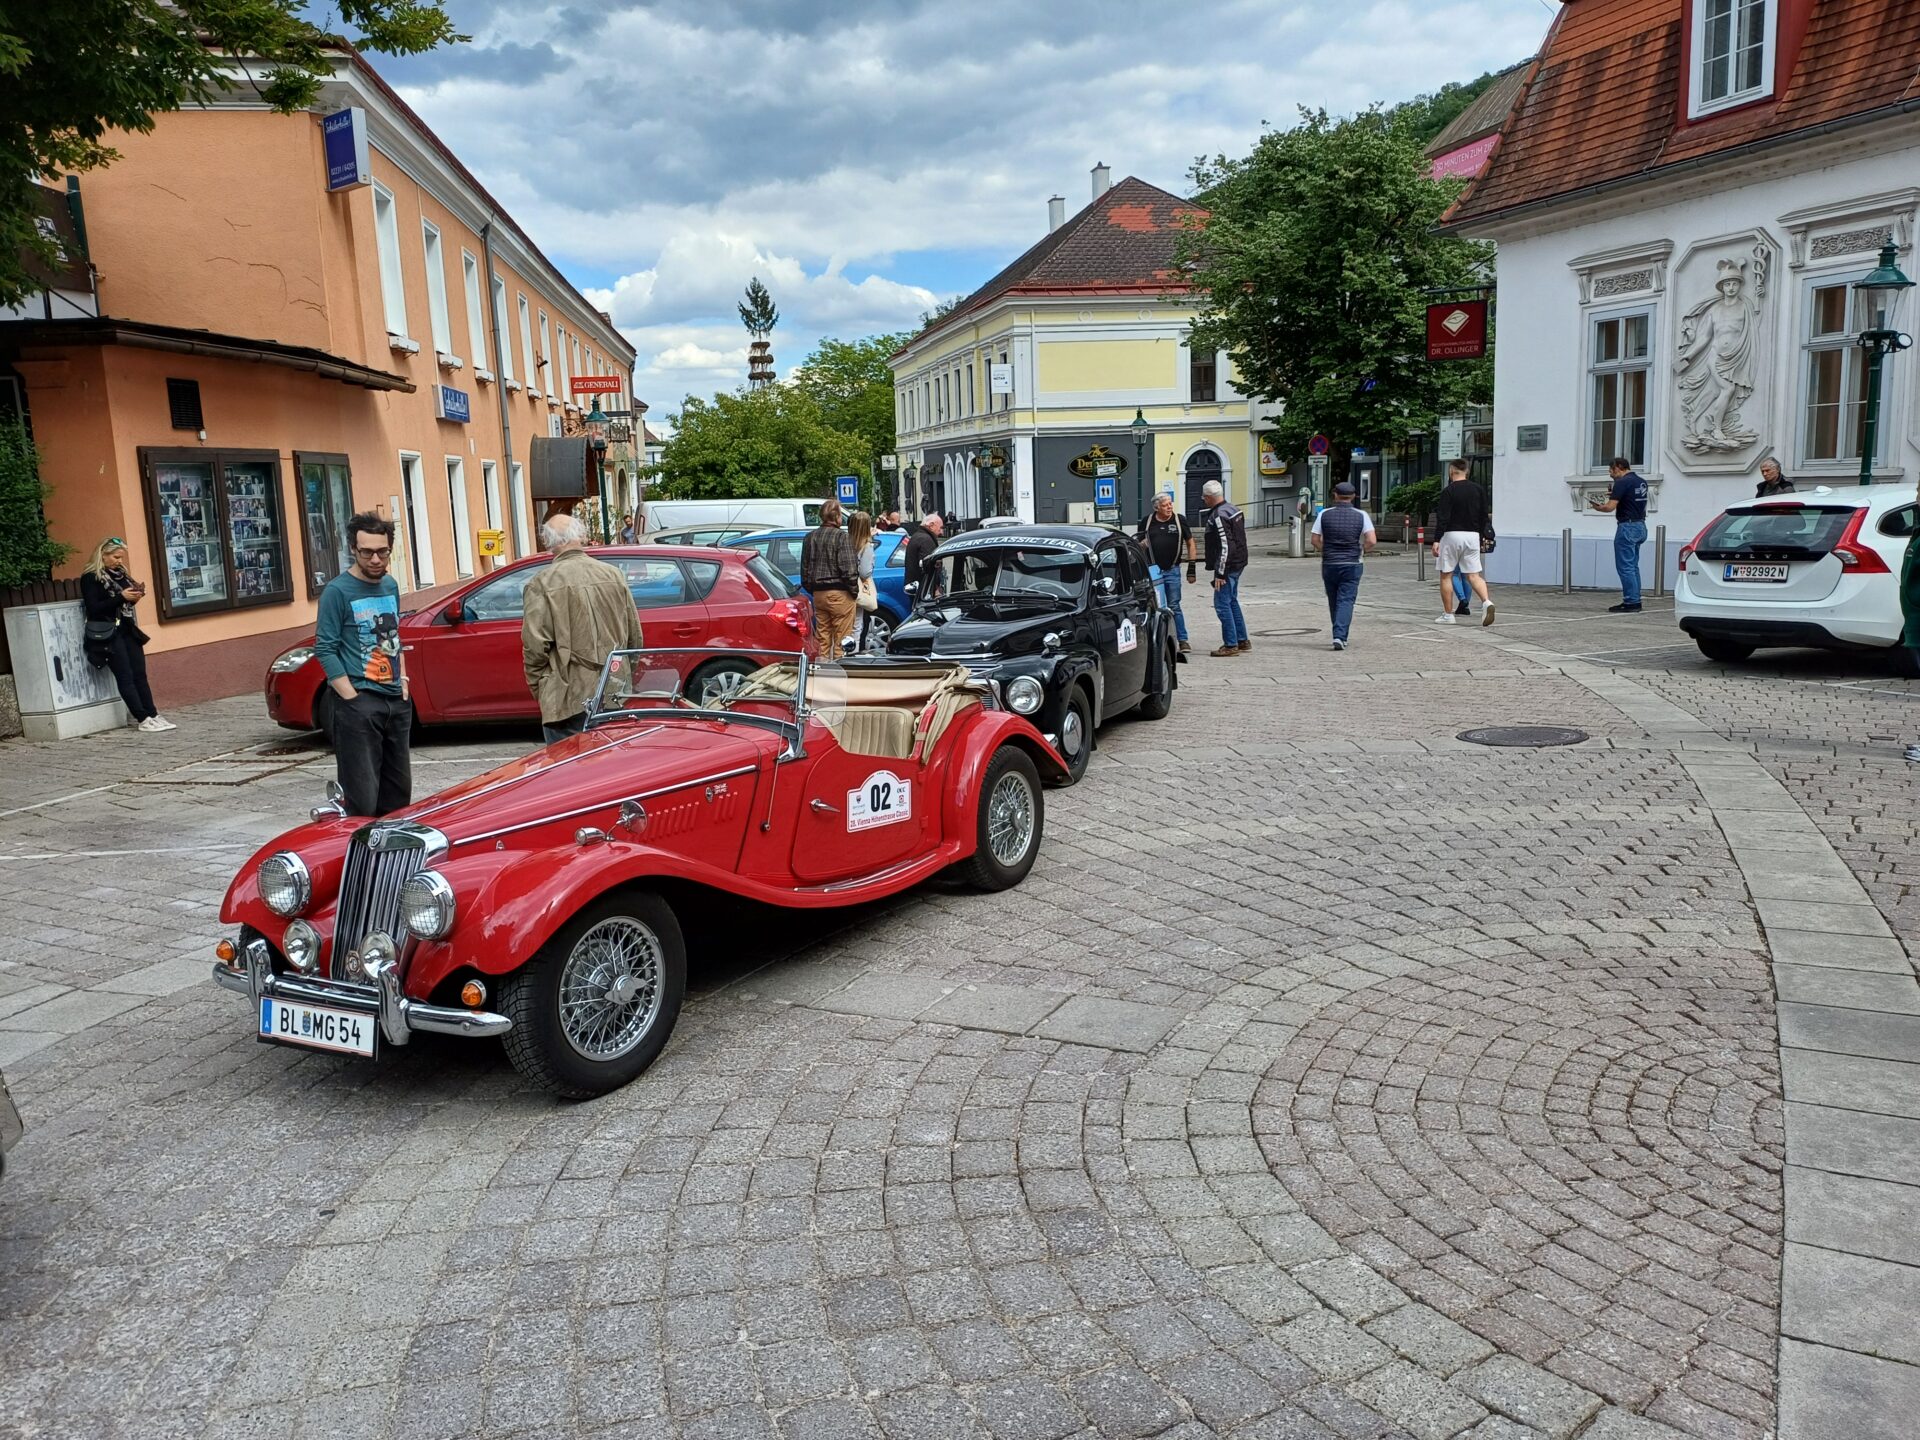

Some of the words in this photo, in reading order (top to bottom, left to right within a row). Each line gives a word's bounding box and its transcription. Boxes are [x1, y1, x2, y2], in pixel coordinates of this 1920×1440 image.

[1444, 151, 1469, 168] MINUTEN
[1470, 146, 1482, 159] ZUM
[1431, 347, 1443, 355] DR.
[1444, 345, 1479, 354] OLLINGER
[584, 381, 618, 389] GENERALI
[984, 536, 1038, 544] CLASSIC
[1043, 538, 1078, 549] TEAM
[1732, 566, 1738, 576] W
[1746, 567, 1777, 577] 92992
[871, 783, 891, 812] 02
[857, 818, 871, 826] Vienna
[896, 809, 908, 817] Classic
[280, 1007, 299, 1035] BL
[313, 1012, 335, 1041] MG
[339, 1016, 361, 1046] 54
